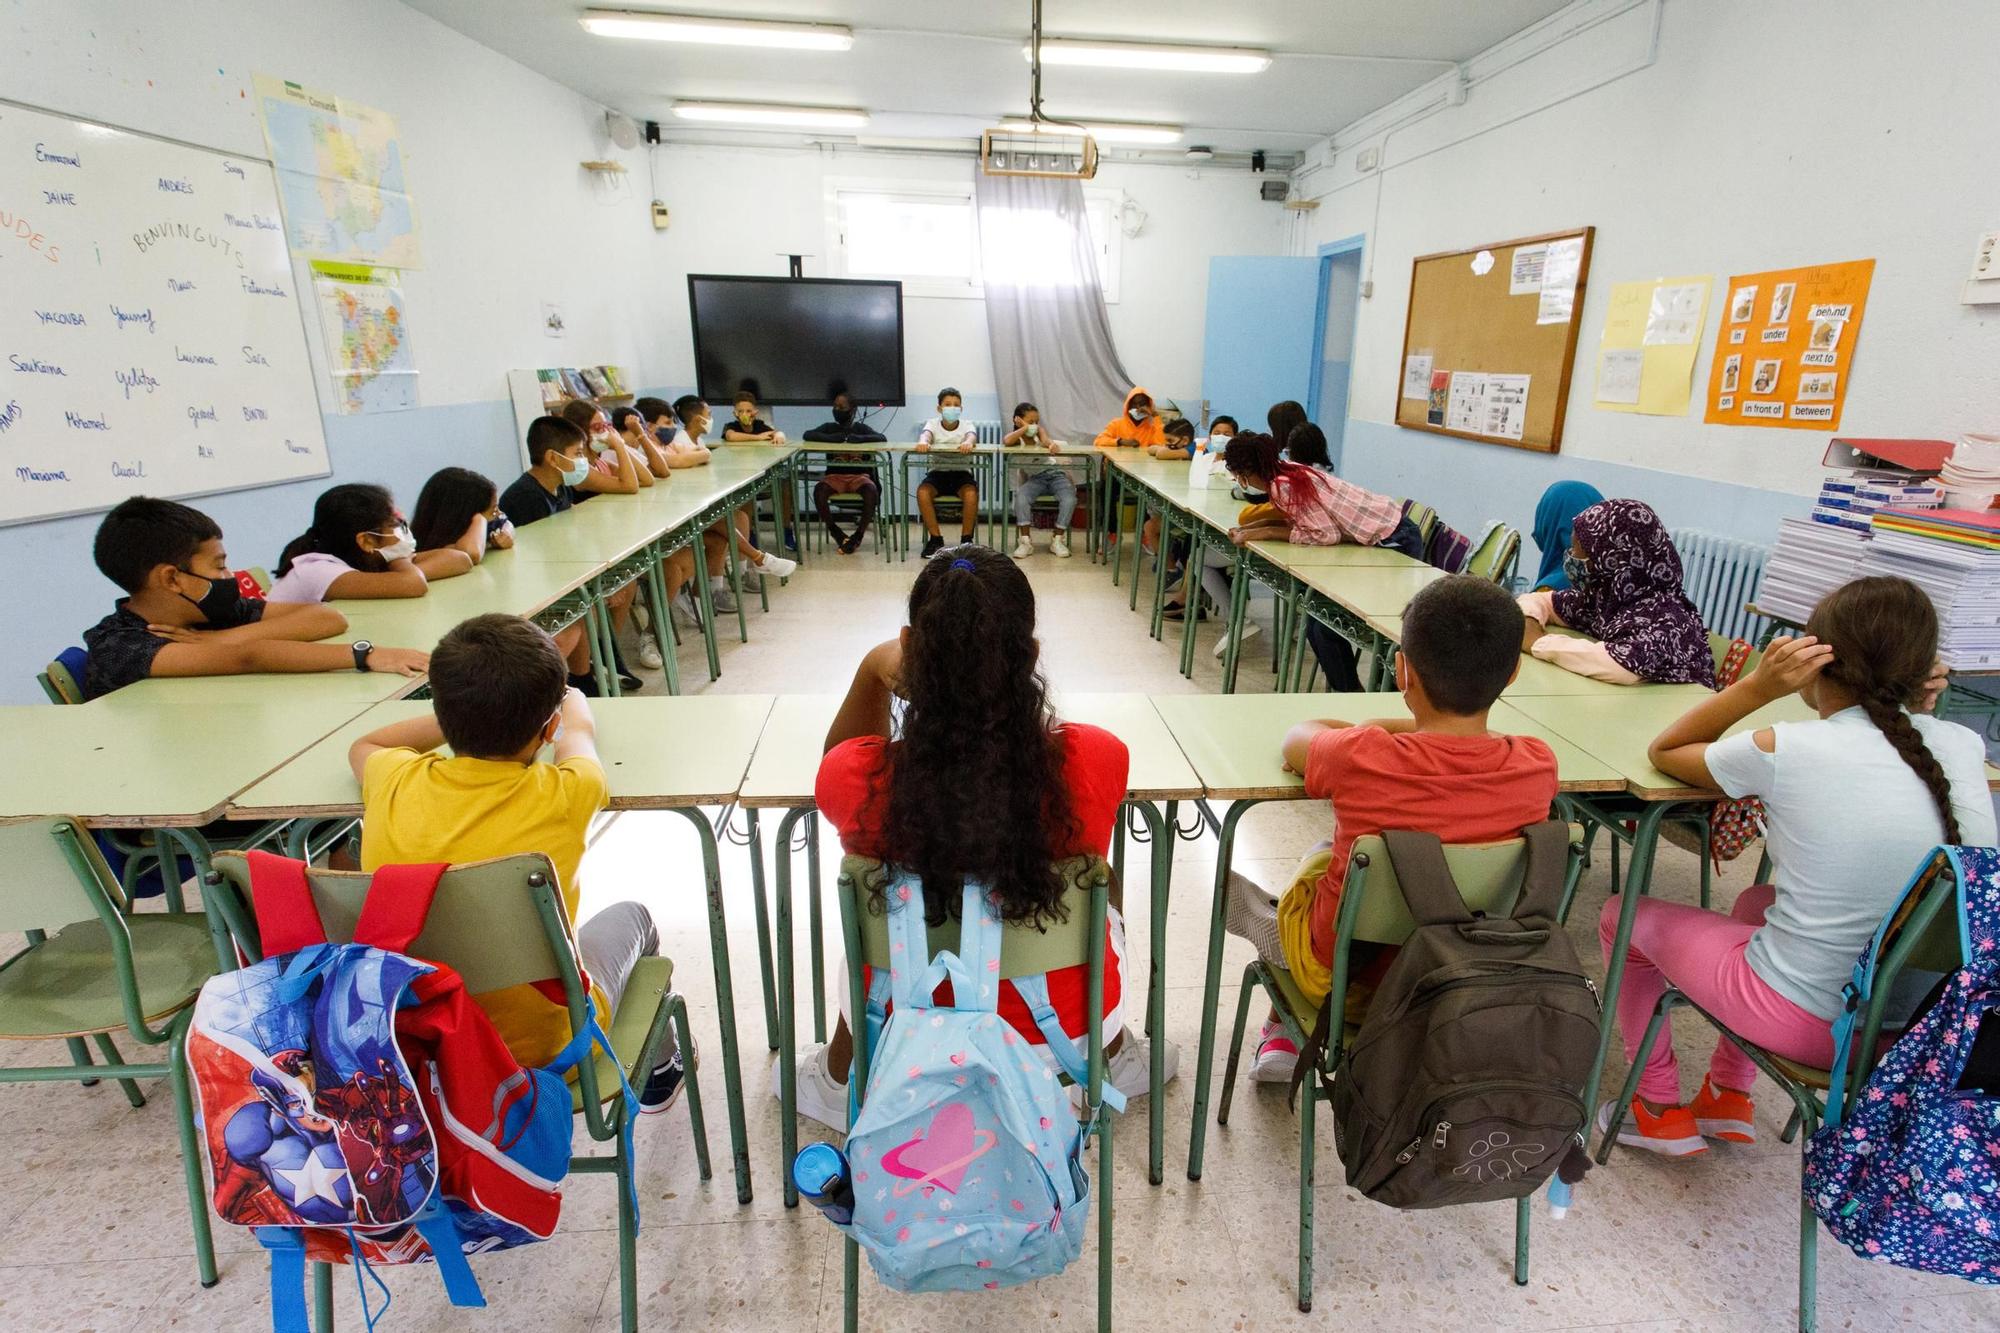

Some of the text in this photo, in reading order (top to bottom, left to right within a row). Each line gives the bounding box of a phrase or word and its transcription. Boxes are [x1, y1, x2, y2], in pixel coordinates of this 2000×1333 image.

[133, 222, 244, 269] BENVINGUTS
[1815, 306, 1847, 318] behind
[1733, 331, 1741, 340] in
[1763, 329, 1786, 340] under
[1804, 353, 1834, 364] next to
[1721, 398, 1731, 406] on
[1744, 404, 1782, 415] in front of
[1794, 405, 1831, 417] between
